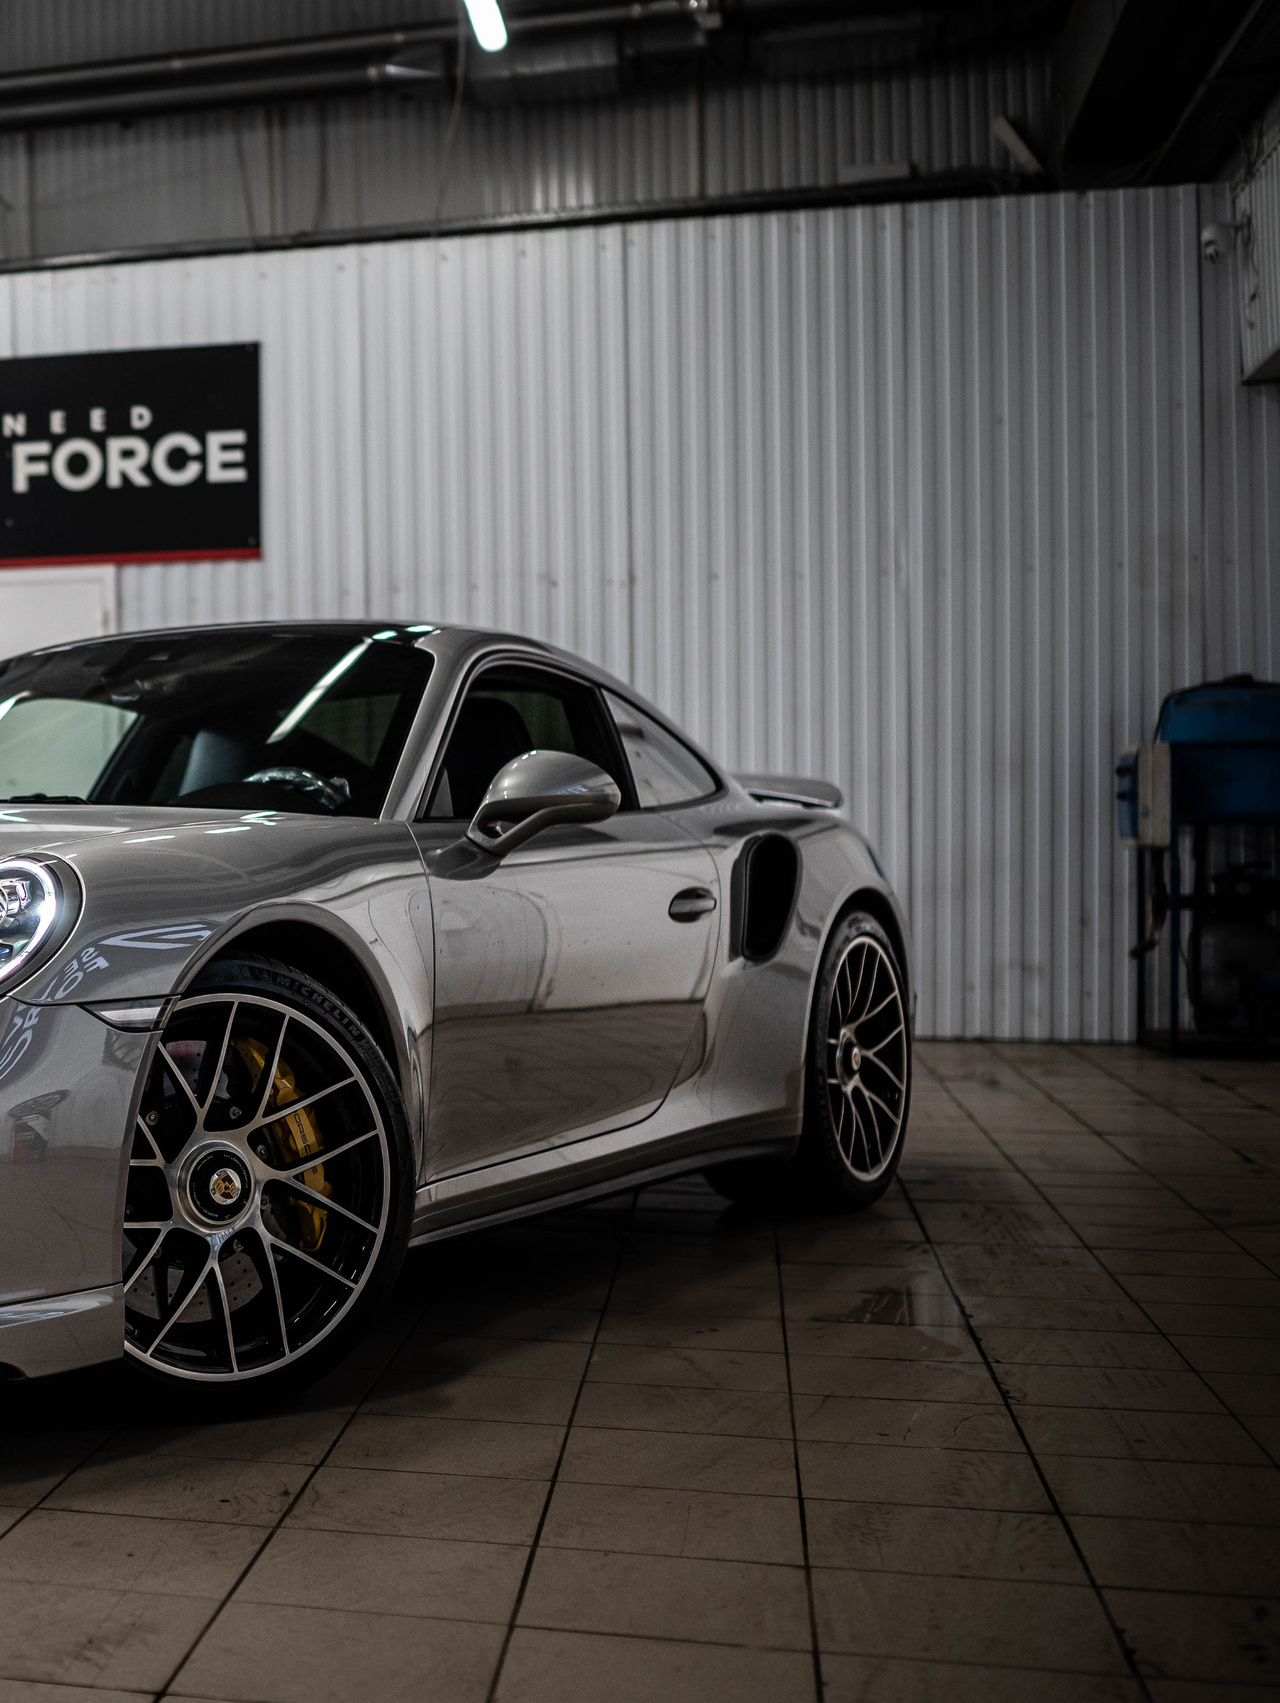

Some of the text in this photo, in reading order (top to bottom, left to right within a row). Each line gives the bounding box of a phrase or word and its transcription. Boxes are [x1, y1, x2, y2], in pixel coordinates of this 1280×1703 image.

[2, 405, 152, 437] NEED
[12, 430, 248, 493] FORCE
[275, 972, 362, 1040] MICHELIN
